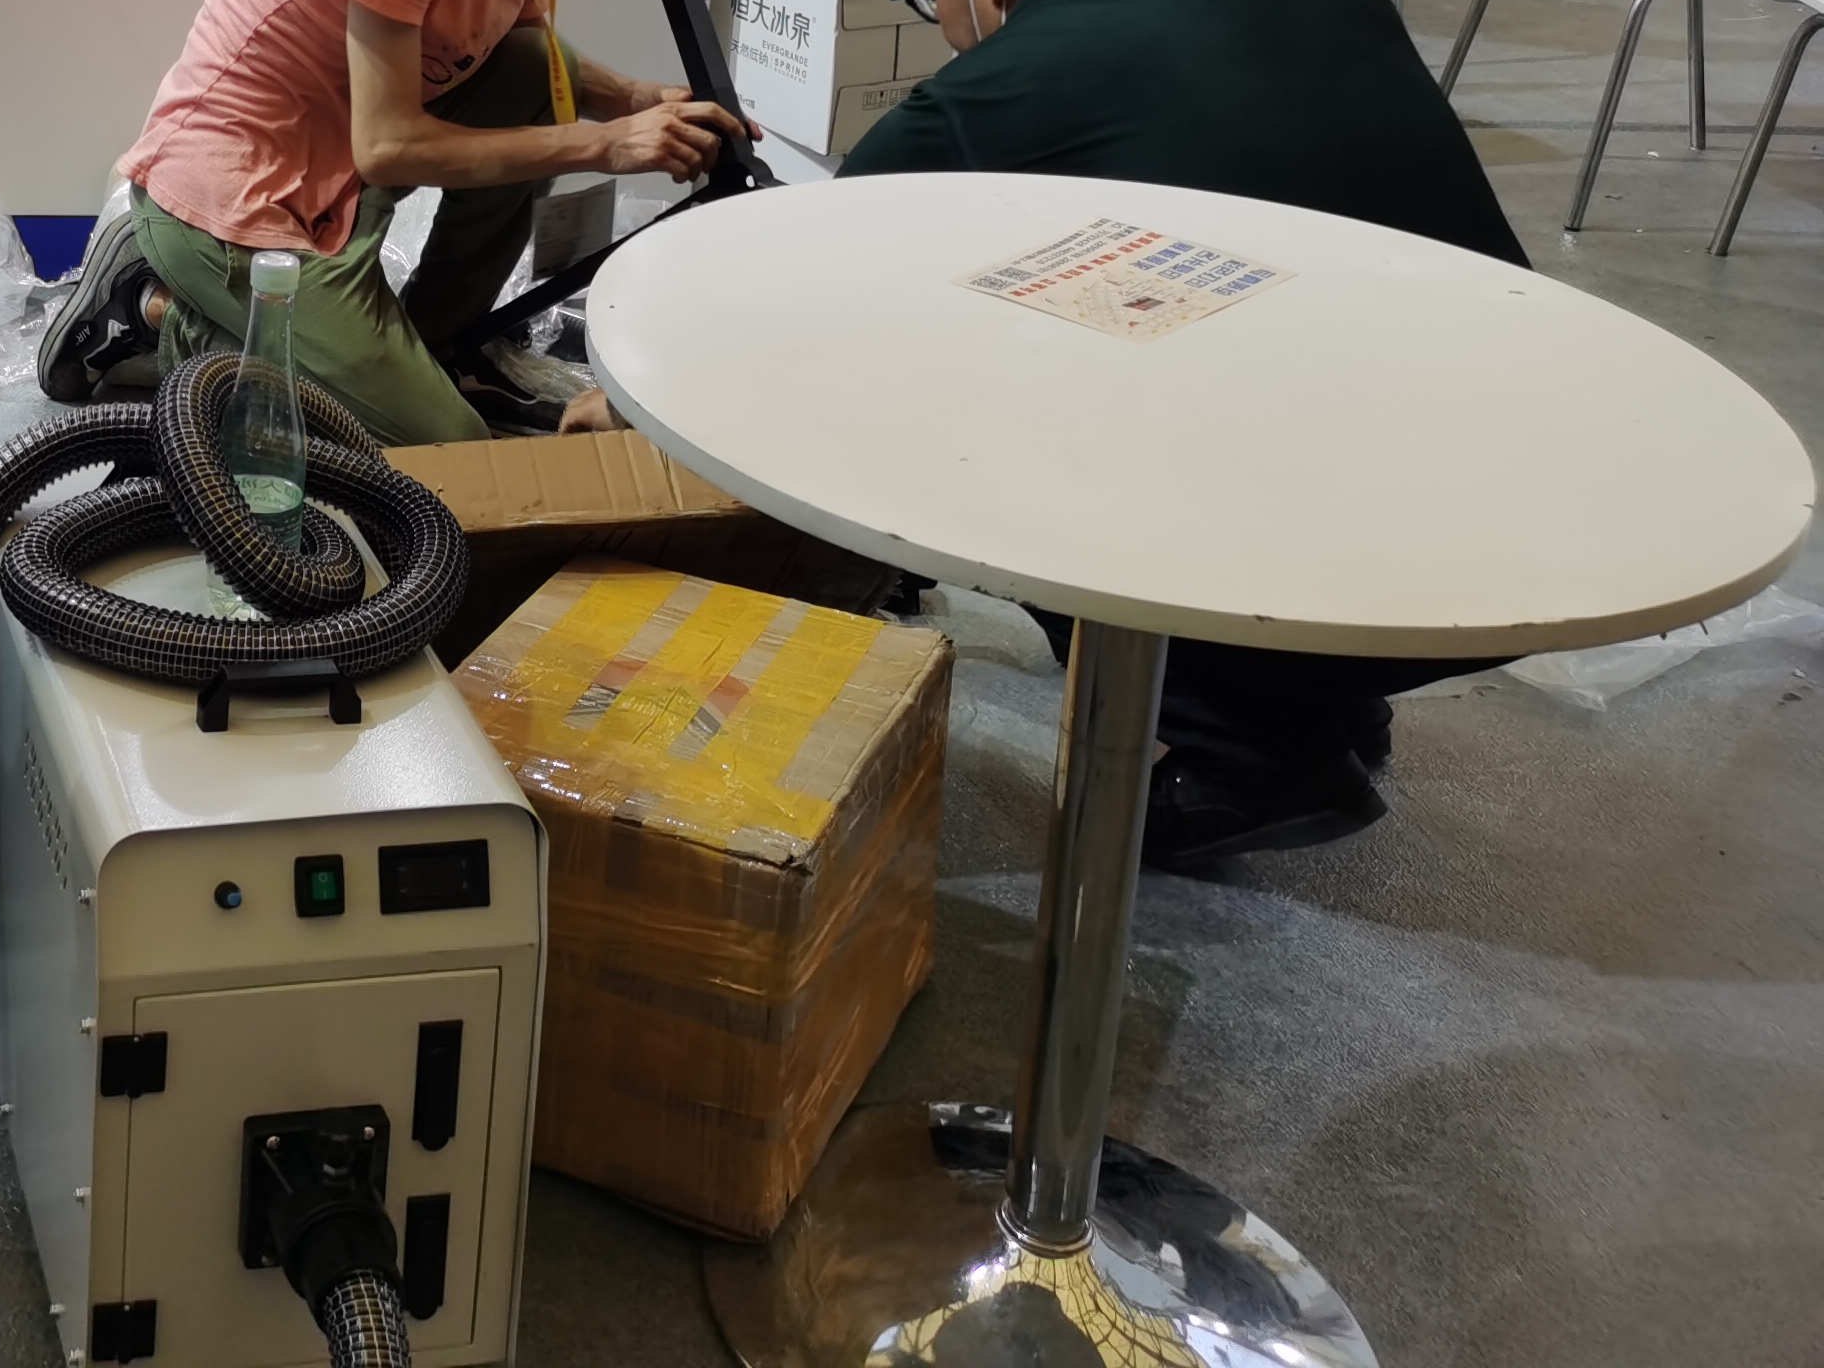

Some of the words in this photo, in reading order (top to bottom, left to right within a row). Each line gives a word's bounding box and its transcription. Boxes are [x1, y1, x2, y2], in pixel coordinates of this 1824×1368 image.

[729, 39, 769, 68] 天然低钠
[762, 39, 809, 68] EVERGRANDE
[774, 57, 808, 79] SPRING
[1183, 258, 1249, 288] 彩色打印
[76, 325, 90, 343] AIR
